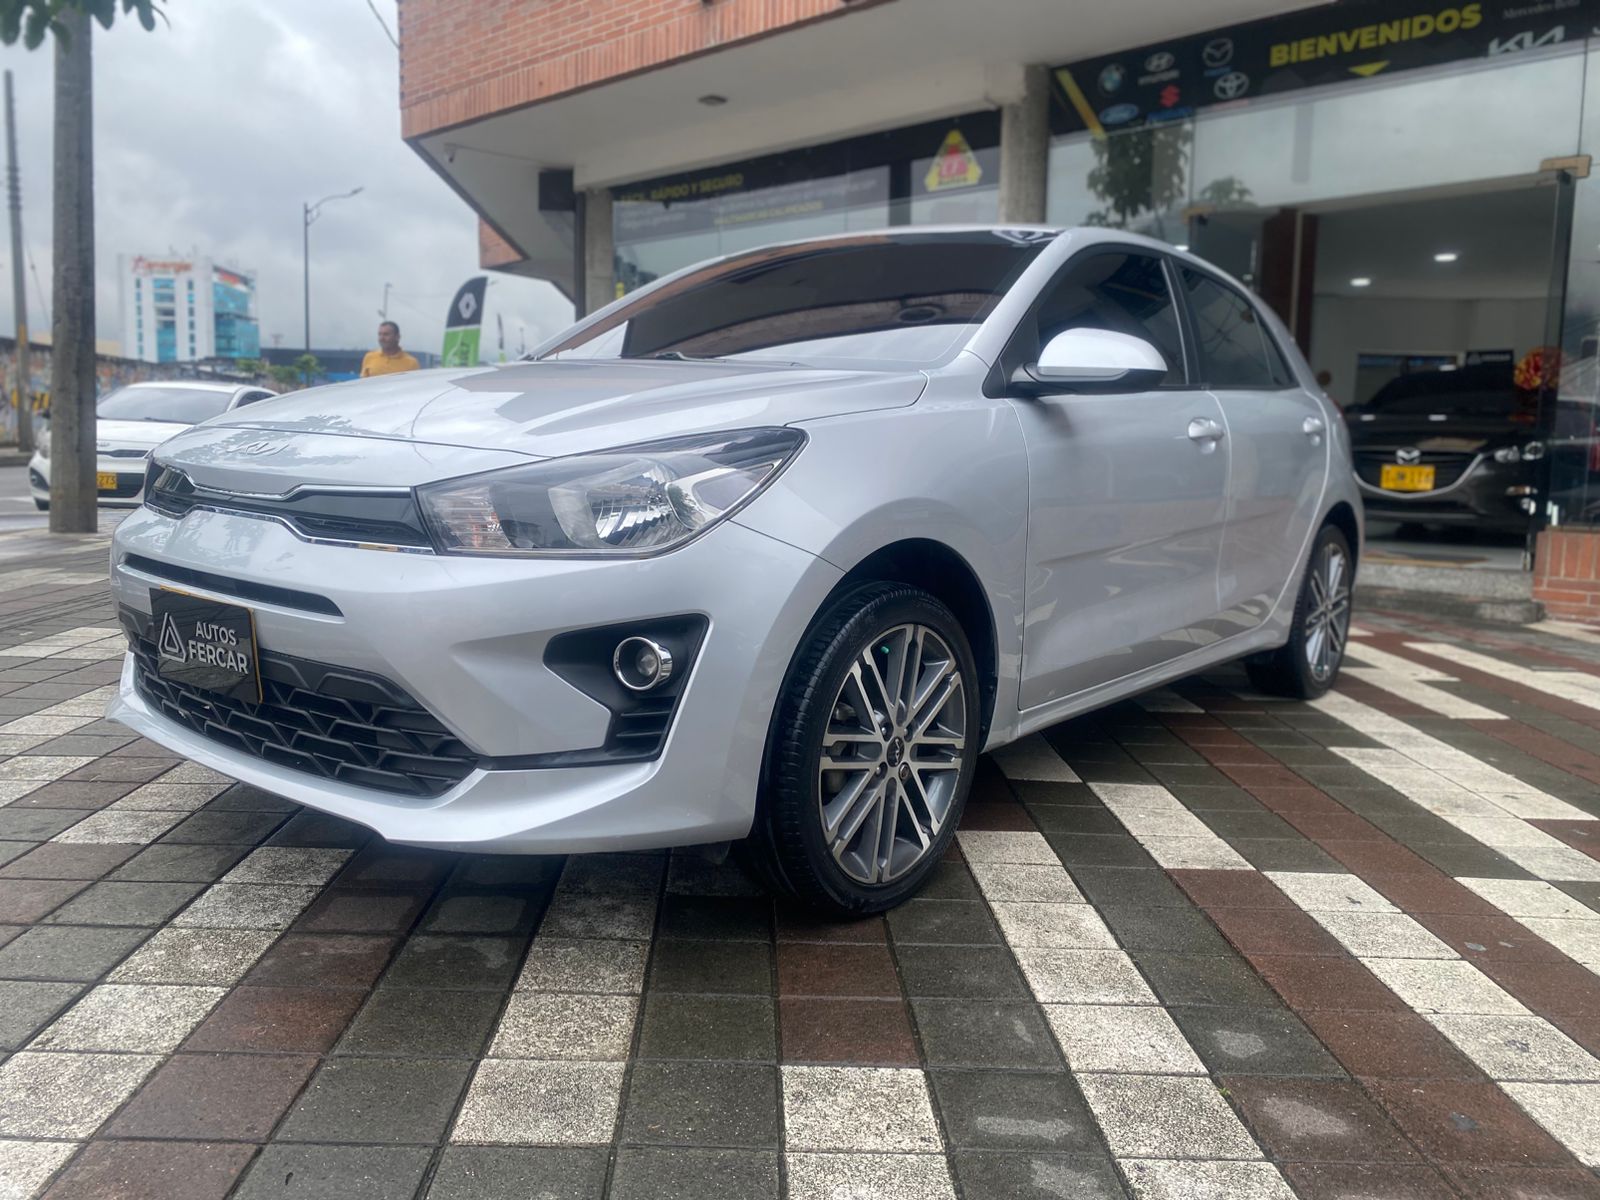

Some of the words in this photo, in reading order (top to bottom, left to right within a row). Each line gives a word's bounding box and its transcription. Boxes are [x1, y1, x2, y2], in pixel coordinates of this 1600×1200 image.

[1270, 4, 1482, 67] BIENVENIDOS
[195, 621, 237, 646] AUTOS
[188, 639, 249, 675] FERCAR
